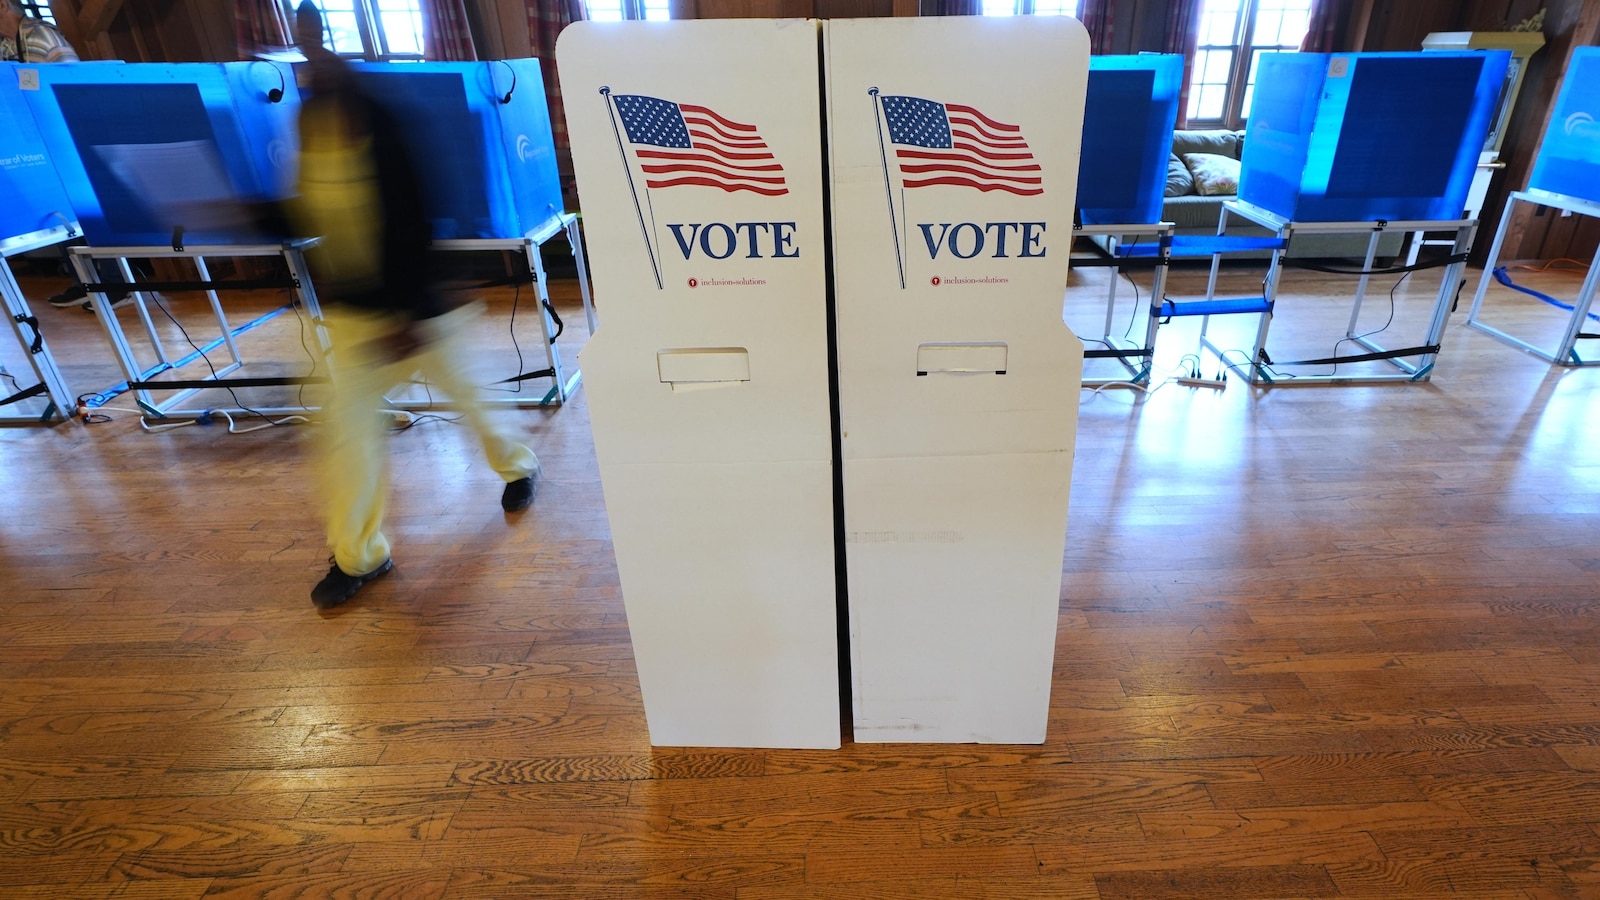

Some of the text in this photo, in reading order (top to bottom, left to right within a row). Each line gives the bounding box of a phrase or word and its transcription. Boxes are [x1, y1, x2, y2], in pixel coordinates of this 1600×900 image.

[1332, 60, 1343, 74] 6
[22, 71, 36, 87] 2
[666, 221, 800, 260] VOTE
[917, 221, 1047, 260] VOTE
[701, 277, 767, 287] inclusion-solutions
[943, 275, 1009, 285] inclusion-solutions
